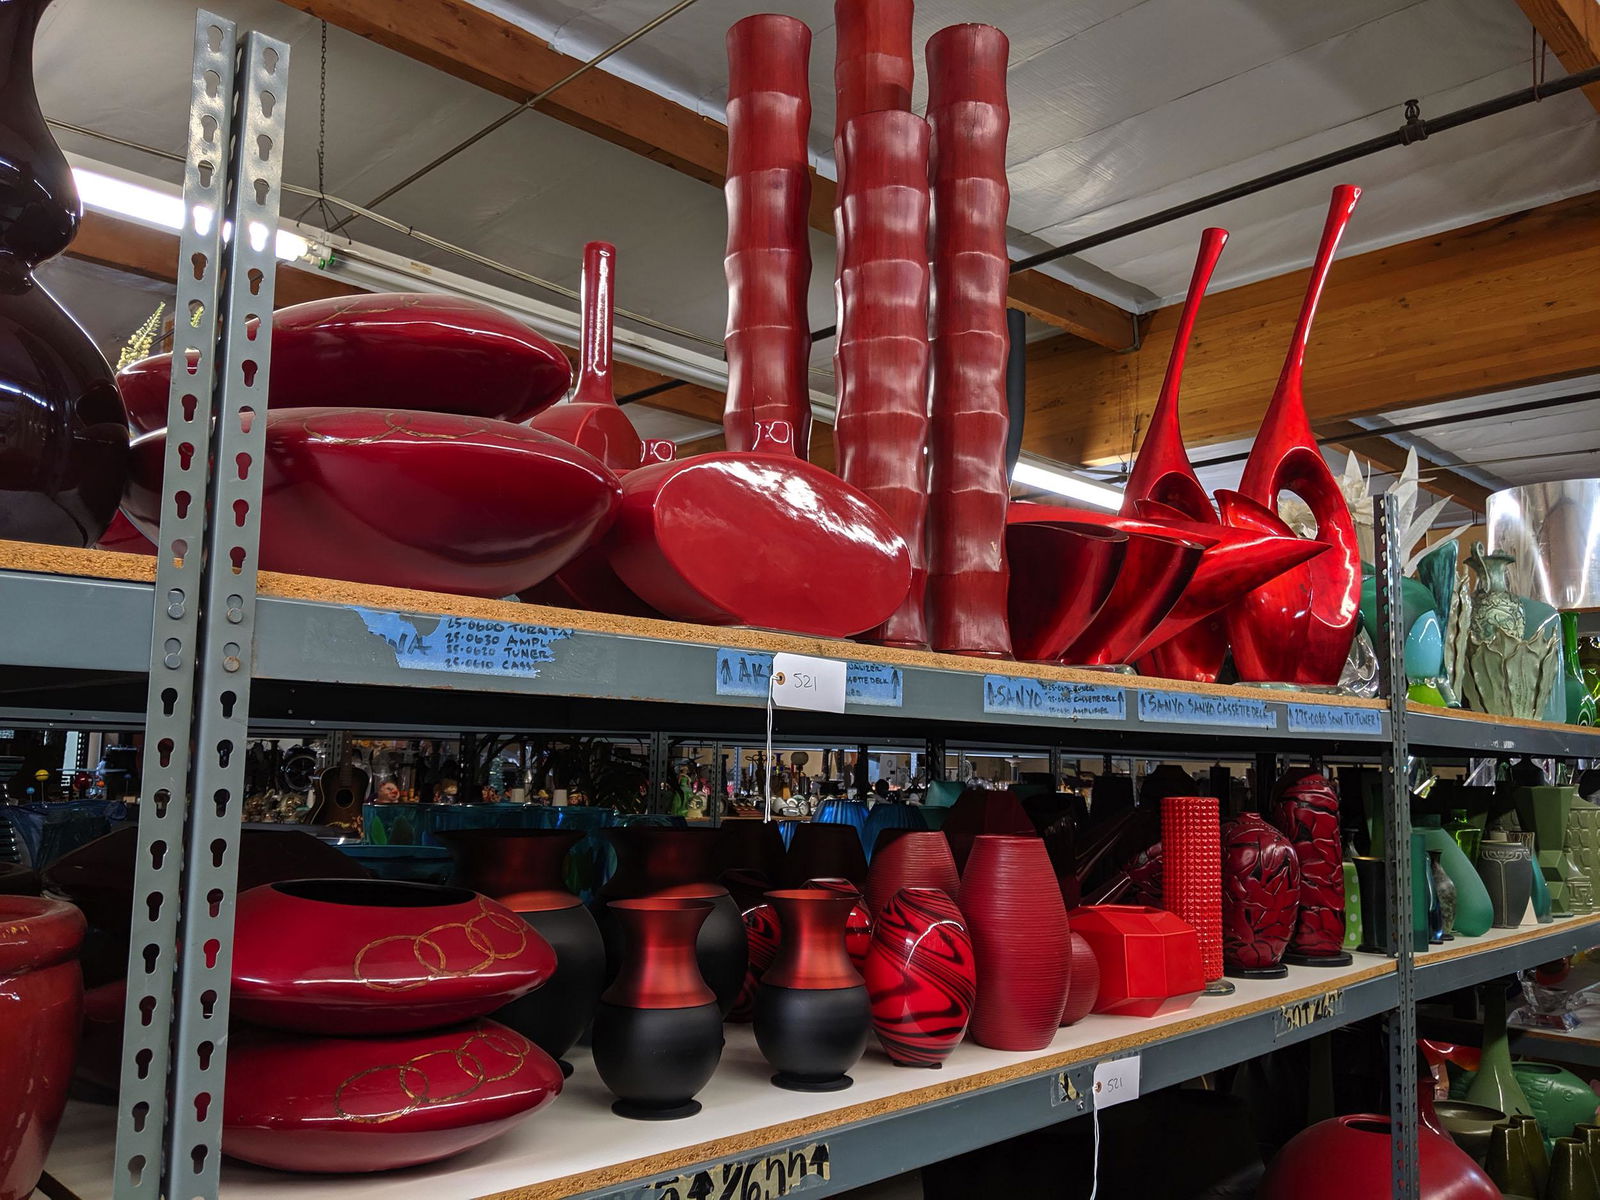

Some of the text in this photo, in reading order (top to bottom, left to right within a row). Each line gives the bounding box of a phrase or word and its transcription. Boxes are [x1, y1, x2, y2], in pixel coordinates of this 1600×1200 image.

[503, 647, 550, 659] TUNER
[793, 673, 817, 691] 521
[996, 683, 1043, 709] SANYO
[1148, 694, 1184, 714] SANYO
[1187, 698, 1214, 716] SANYO
[1216, 701, 1251, 719] CASSETTE
[1107, 1077, 1124, 1093] 521
